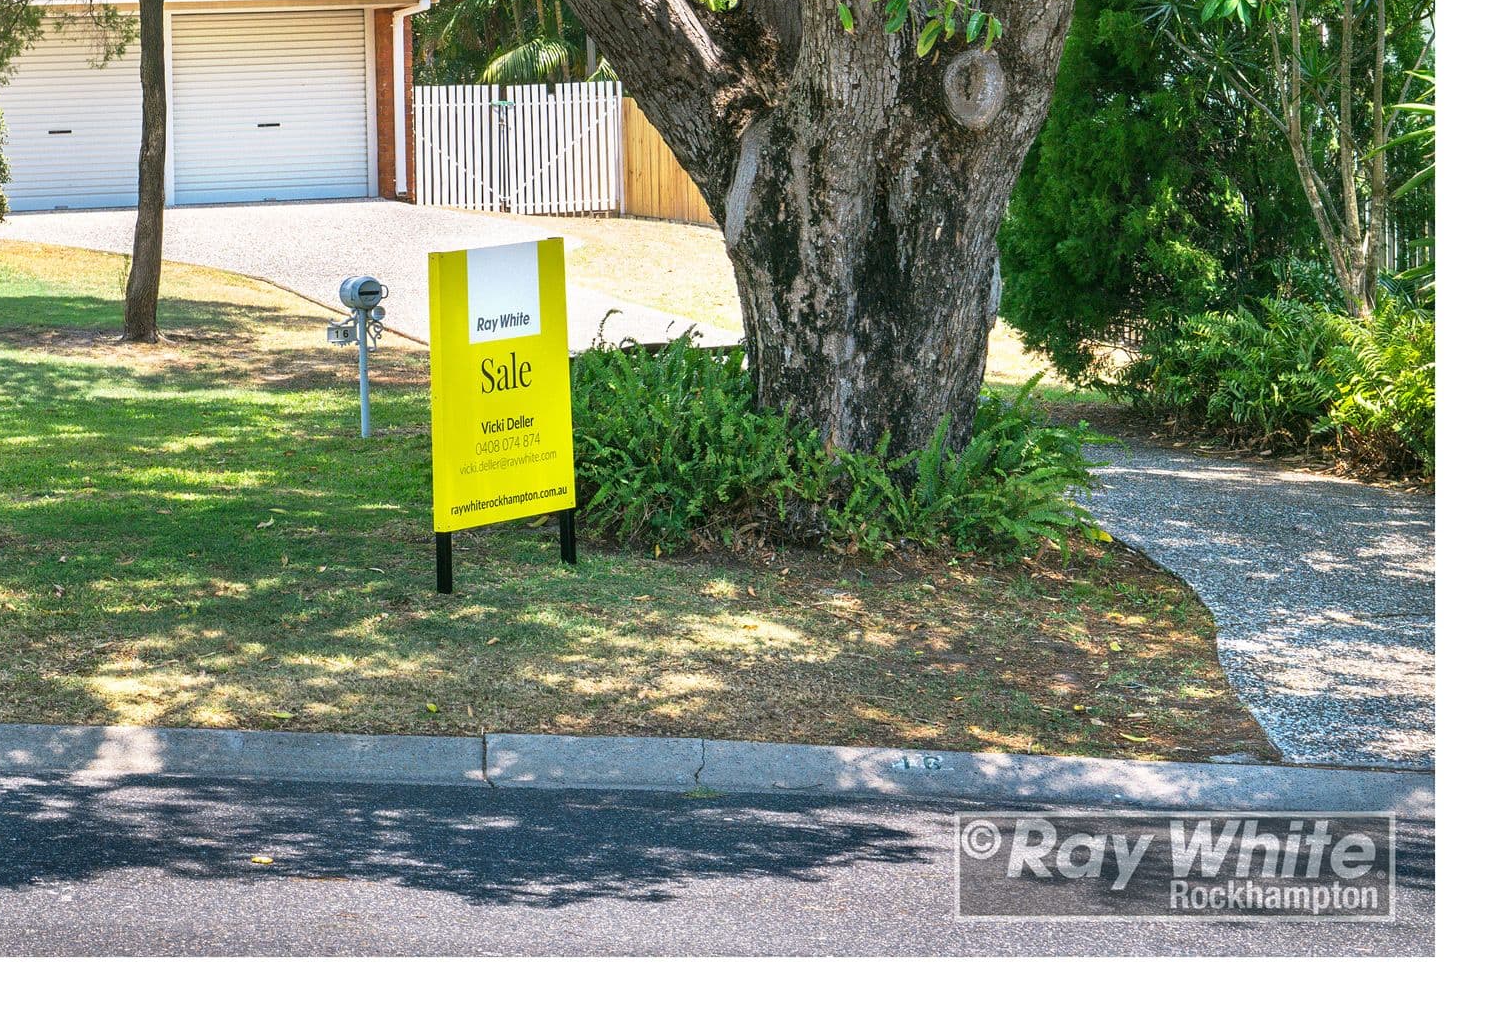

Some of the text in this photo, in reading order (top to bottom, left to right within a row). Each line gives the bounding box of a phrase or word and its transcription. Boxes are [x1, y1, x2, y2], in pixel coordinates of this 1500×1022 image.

[335, 329, 349, 339] 16
[477, 312, 530, 333] Ray White
[481, 351, 532, 395] Sale
[481, 415, 534, 435] Vicki Deller
[475, 432, 541, 456] 0408 074 874
[459, 450, 557, 475] vicki.deller@raywhite.com
[450, 486, 567, 516] raywhiterockhampton.com.au
